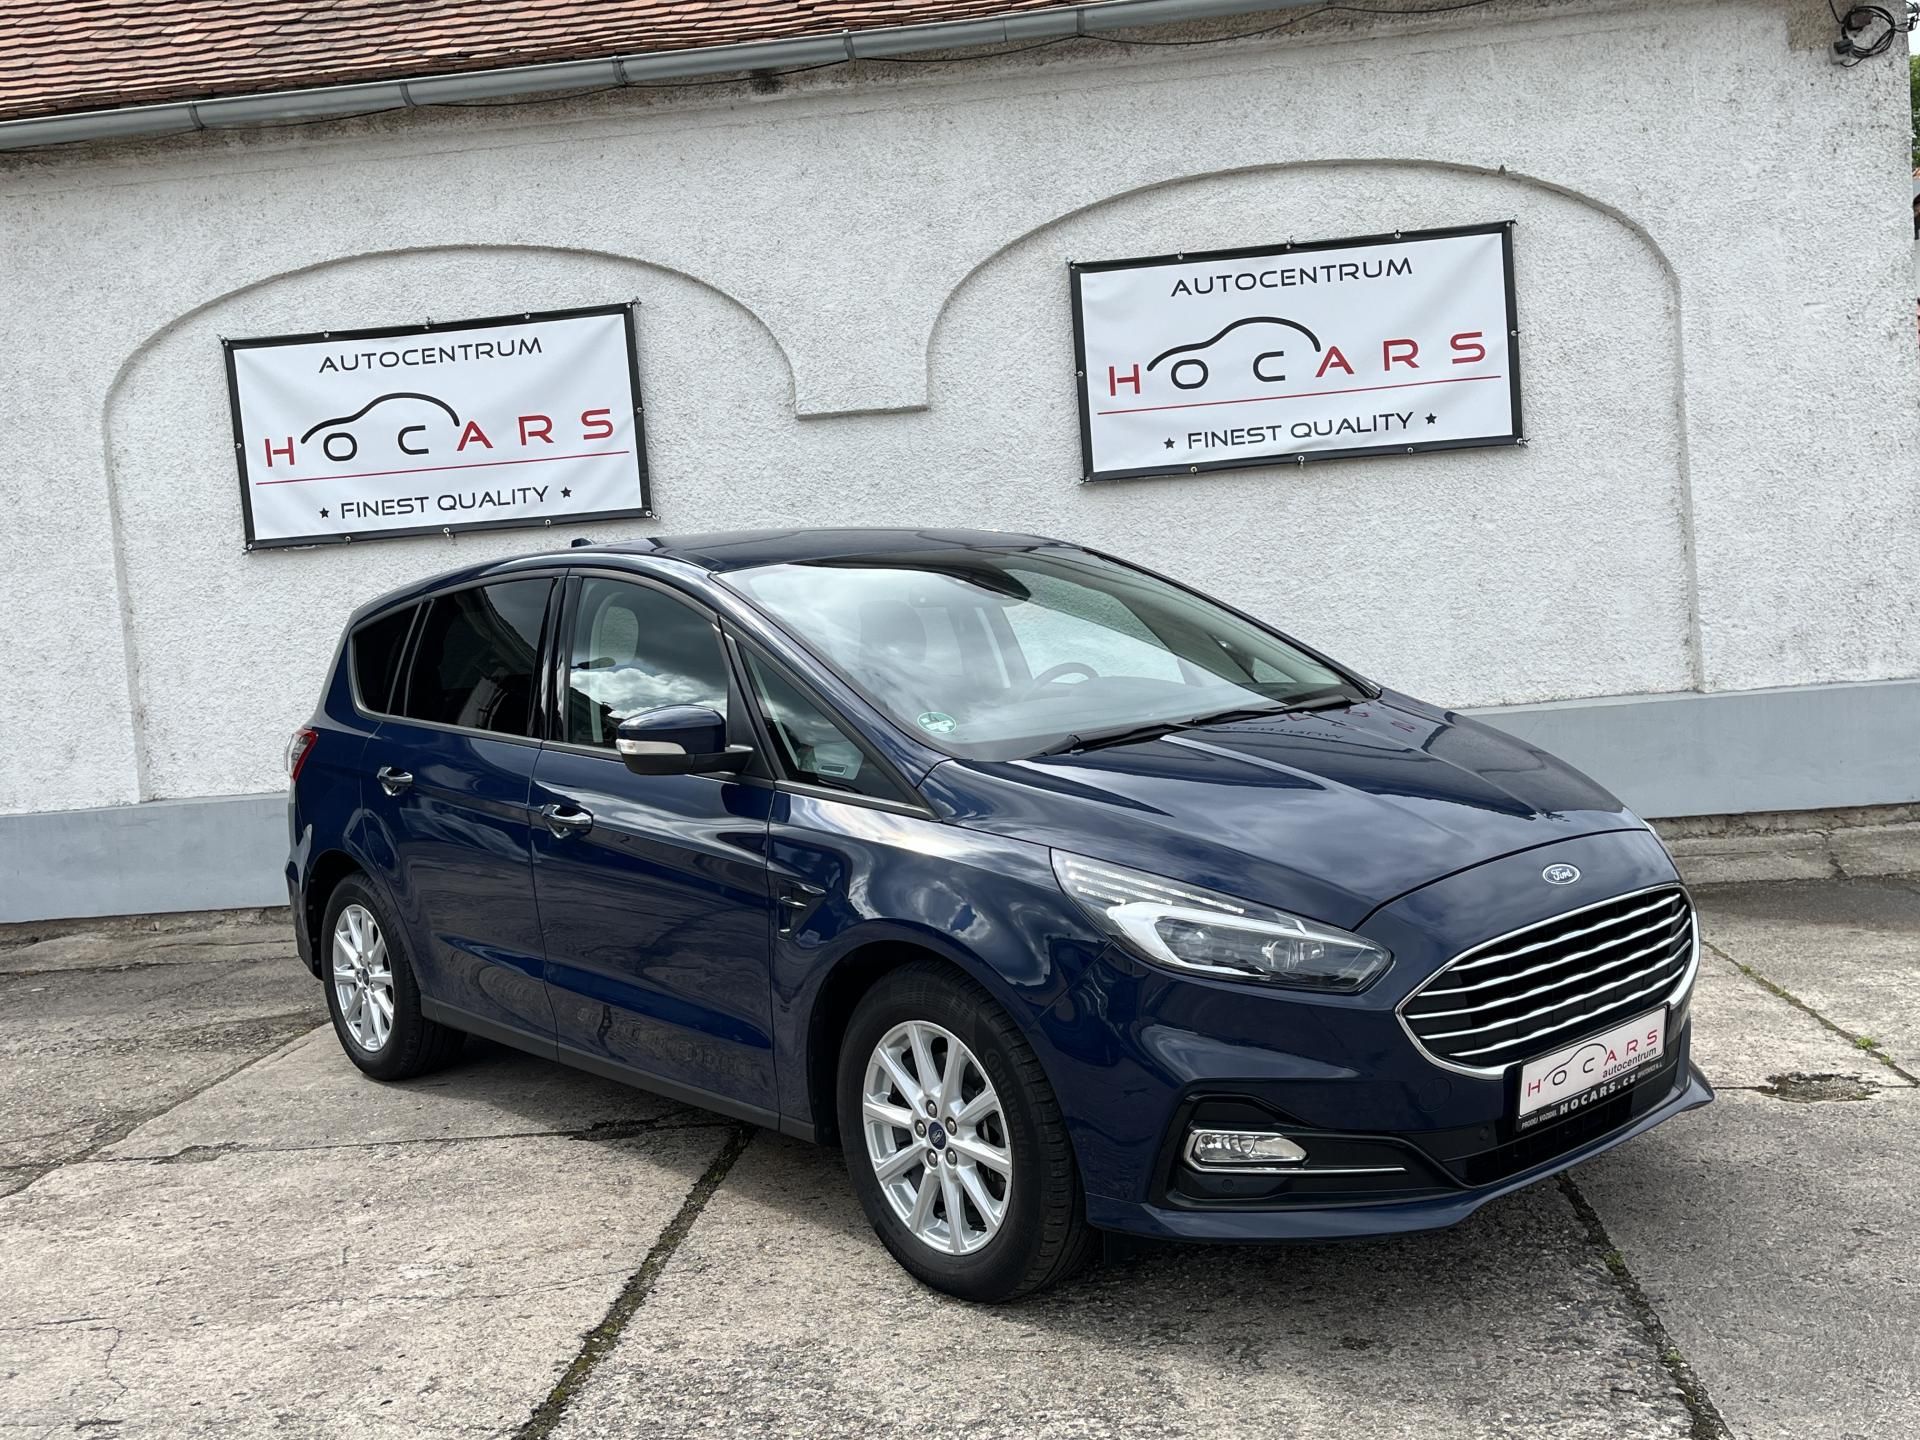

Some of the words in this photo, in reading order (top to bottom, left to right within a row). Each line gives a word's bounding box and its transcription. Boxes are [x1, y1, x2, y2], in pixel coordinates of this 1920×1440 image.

[1170, 256, 1413, 297] AUTOCENTRUM
[318, 336, 543, 374] AUTOCENTRUM
[1187, 424, 1283, 450] FINEST
[1290, 411, 1414, 439] QUALITY
[340, 496, 430, 519] FINEST
[437, 485, 549, 511] QUALITY
[1602, 1047, 1657, 1079] autocentrum
